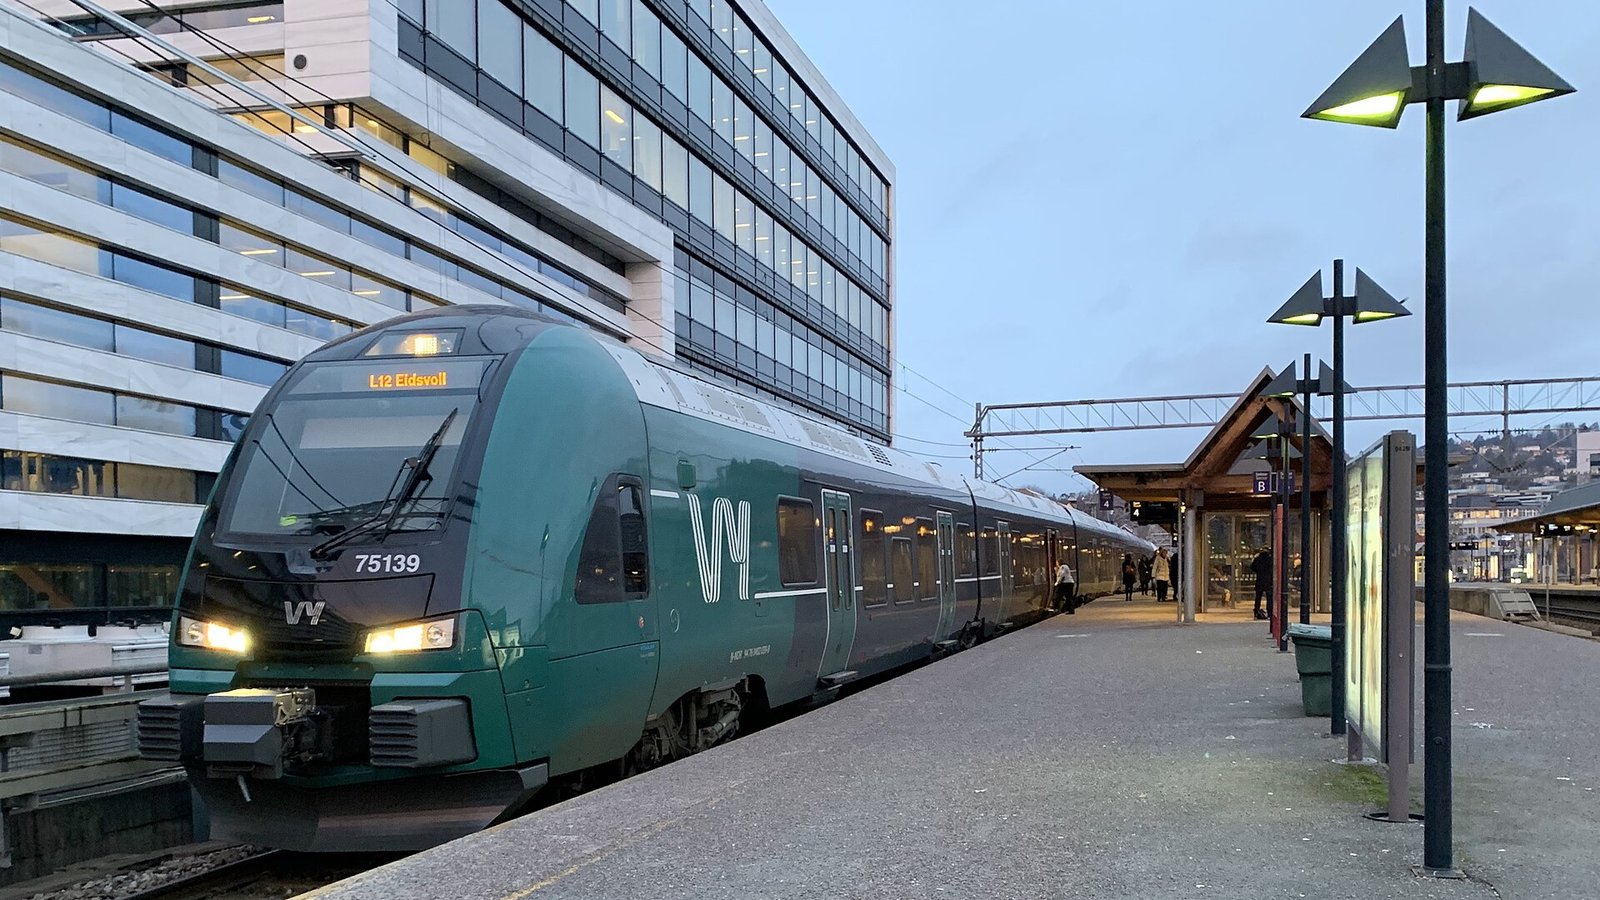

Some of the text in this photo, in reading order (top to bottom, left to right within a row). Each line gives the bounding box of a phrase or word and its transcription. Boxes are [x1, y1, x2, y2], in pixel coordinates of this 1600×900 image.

[369, 371, 447, 388] L12 Eidsvoll
[1258, 480, 1266, 492] B
[1103, 500, 1110, 508] 4
[1133, 508, 1140, 517] 4
[355, 554, 421, 573] 75139
